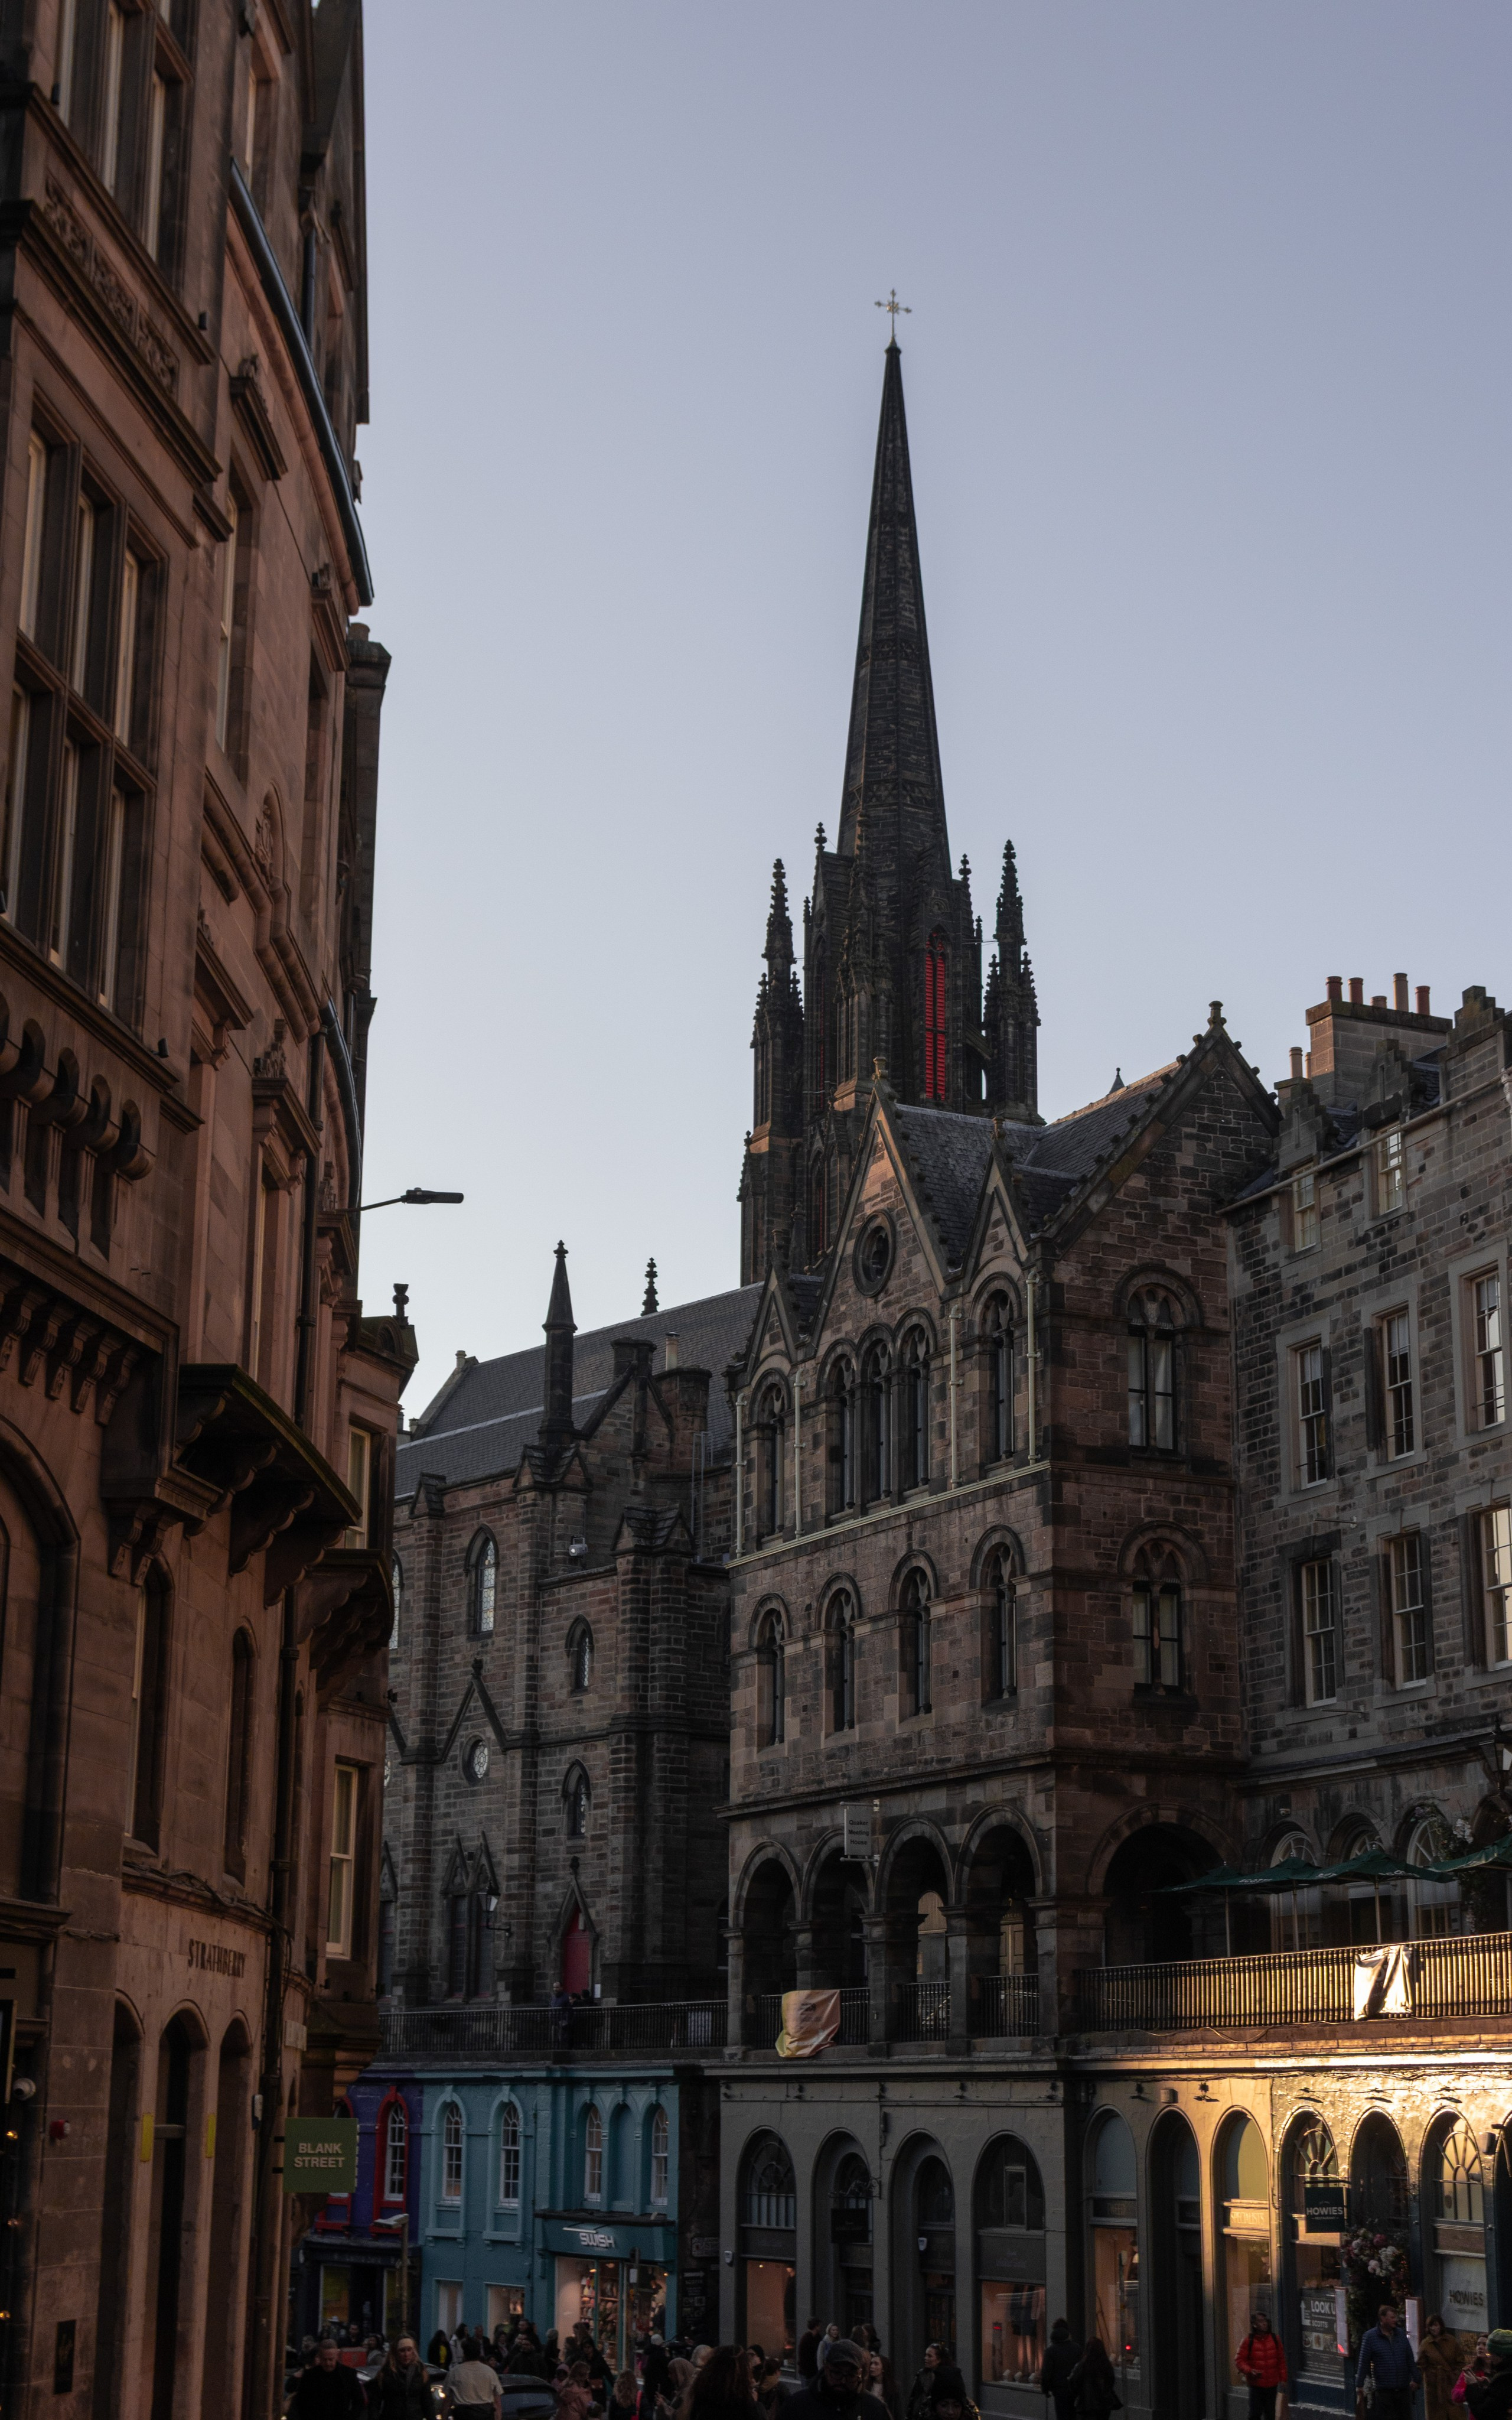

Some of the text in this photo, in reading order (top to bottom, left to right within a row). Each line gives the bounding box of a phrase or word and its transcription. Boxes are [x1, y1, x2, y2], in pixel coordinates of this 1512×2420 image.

[188, 1938, 246, 1978] STRATHBERRY
[298, 2142, 343, 2154] BLANK
[294, 2156, 346, 2168] STREET
[1306, 2207, 1344, 2216] HOWIES
[579, 2232, 615, 2248] SWISH
[1449, 2289, 1483, 2306] HOWIES
[1311, 2300, 1331, 2314] LOOK
[1331, 2302, 1336, 2315] U
